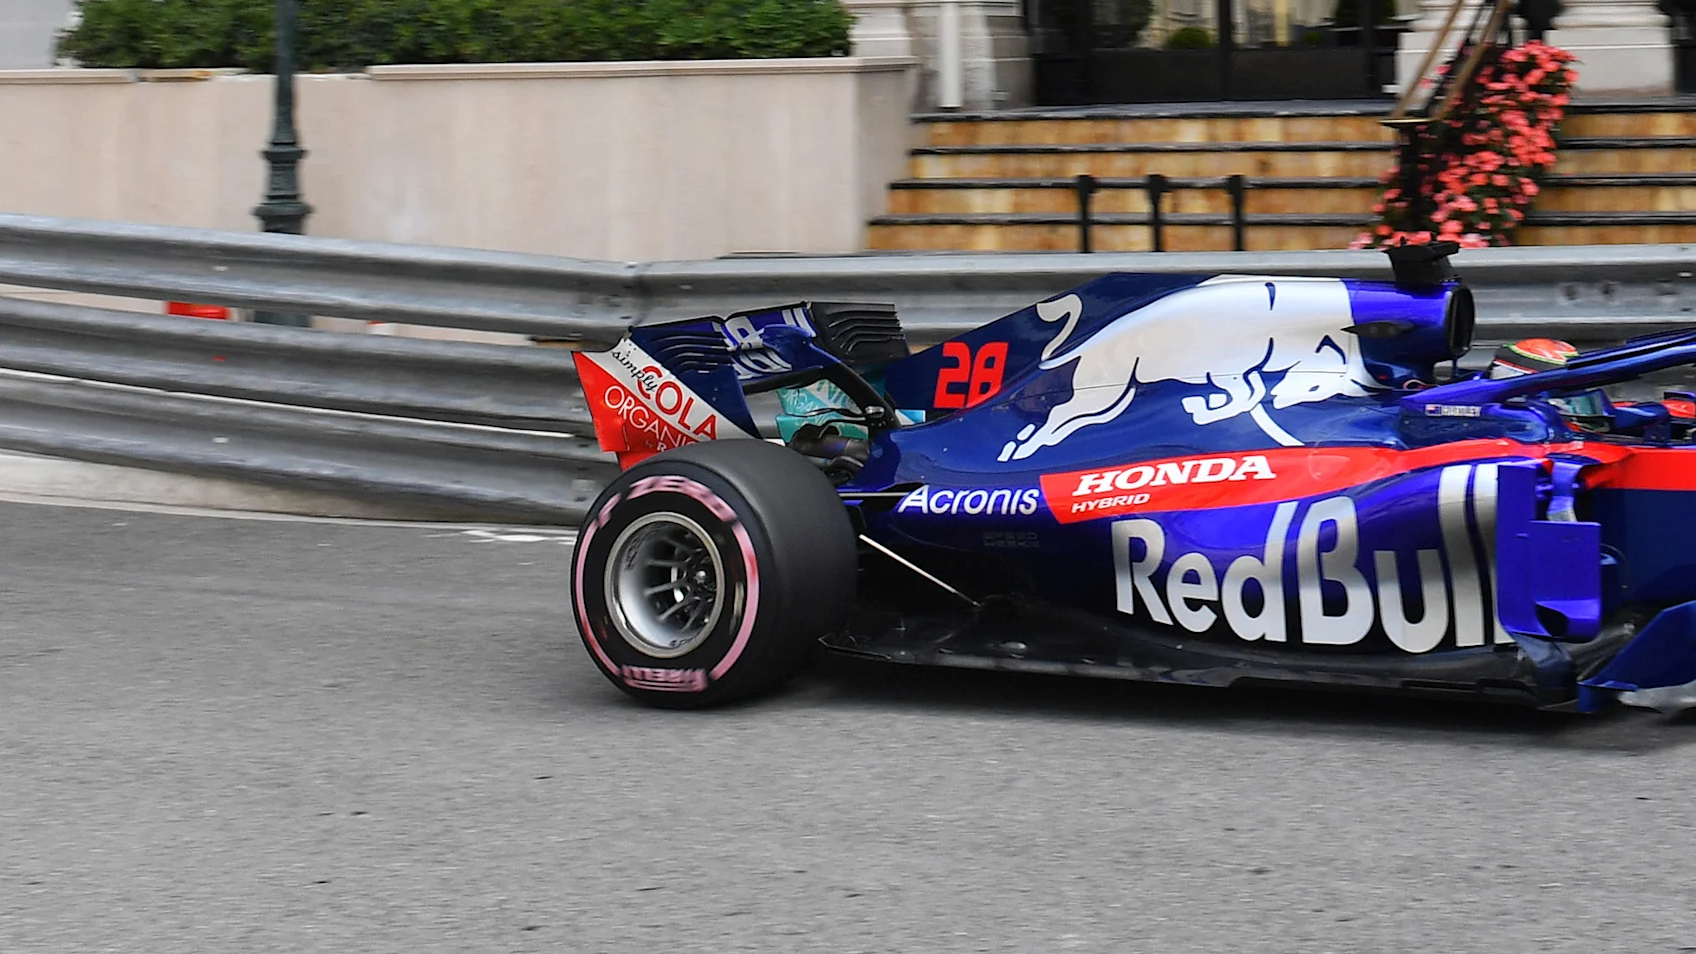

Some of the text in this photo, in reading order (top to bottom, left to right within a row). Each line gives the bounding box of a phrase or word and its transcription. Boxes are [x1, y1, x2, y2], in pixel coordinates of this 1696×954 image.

[611, 345, 661, 393] simply
[933, 341, 1009, 409] 28
[604, 385, 700, 447] ORGANI
[637, 365, 718, 441] COLA
[898, 484, 1040, 515] Acronis
[1072, 455, 1277, 496] HONDA
[1071, 493, 1150, 513] HYBRID
